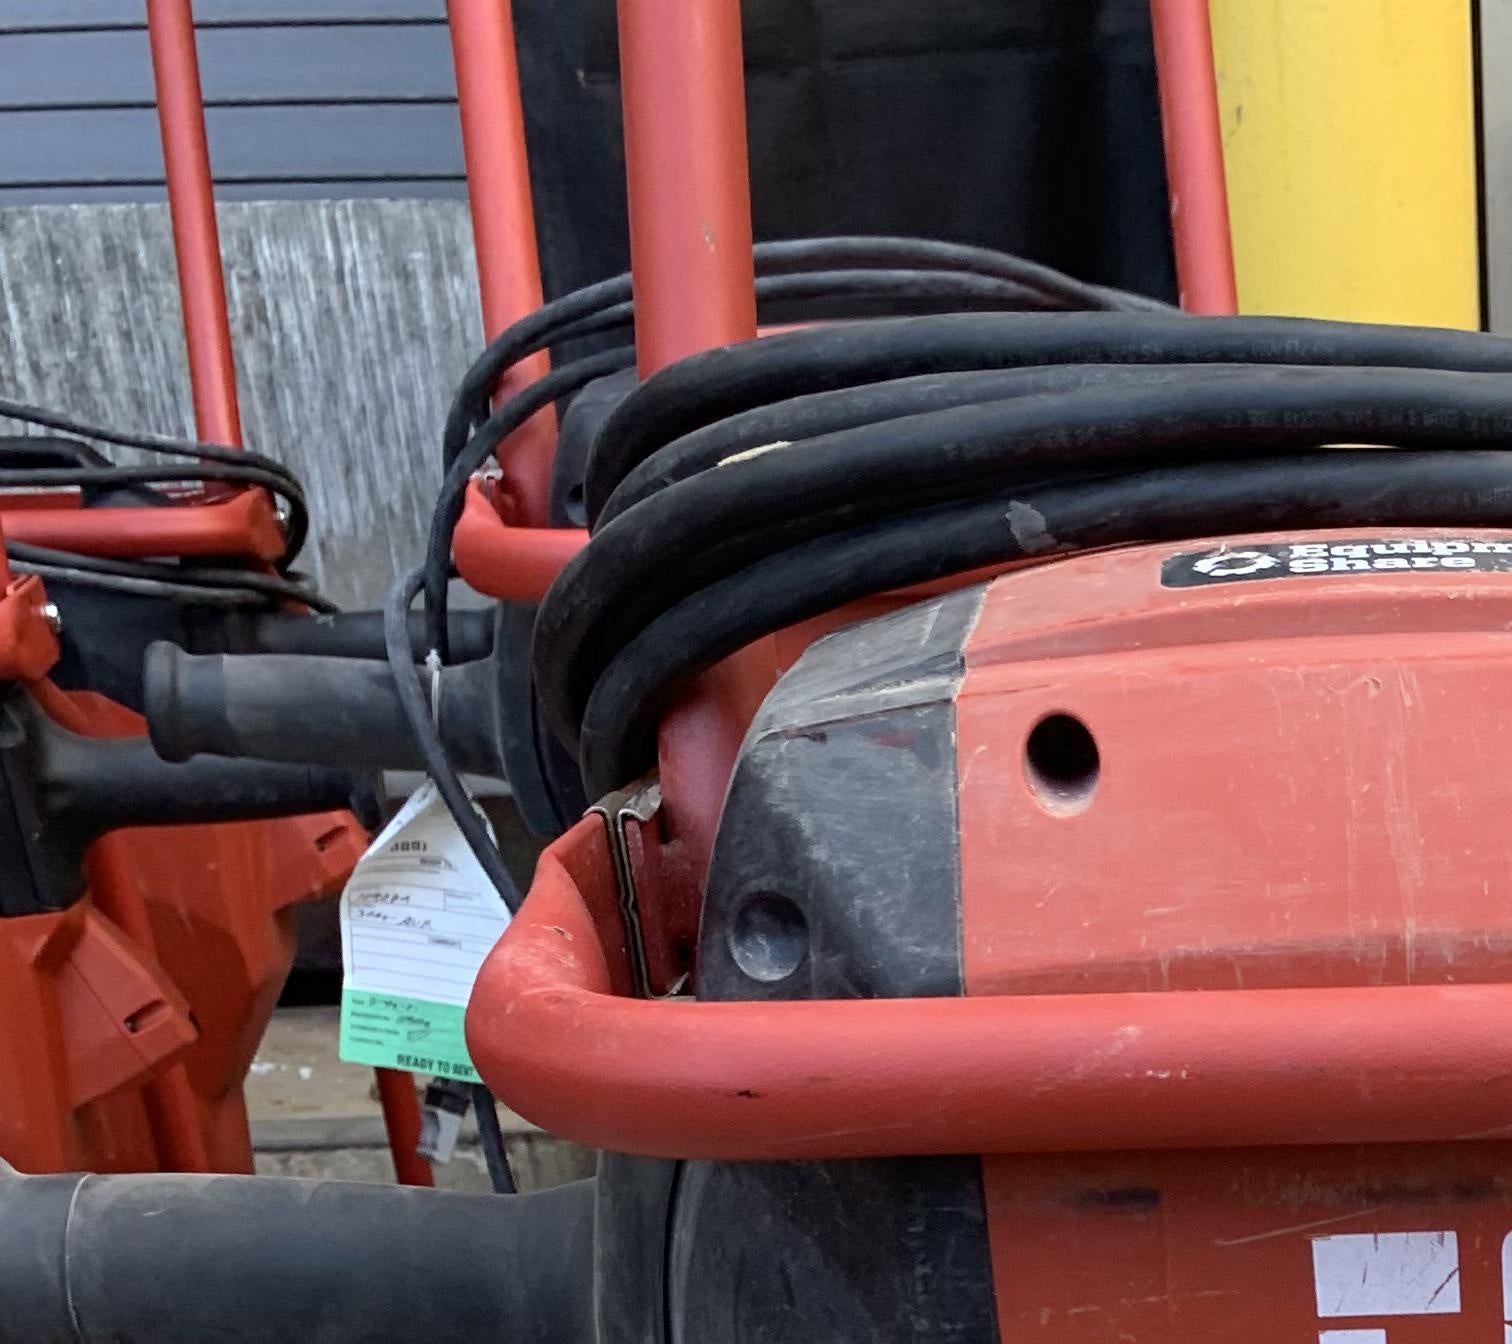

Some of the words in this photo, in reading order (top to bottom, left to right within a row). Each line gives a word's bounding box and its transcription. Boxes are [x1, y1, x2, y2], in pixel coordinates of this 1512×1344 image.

[1288, 556, 1477, 574] Share
[396, 1054, 434, 1071] READY
[437, 1060, 449, 1073] TO
